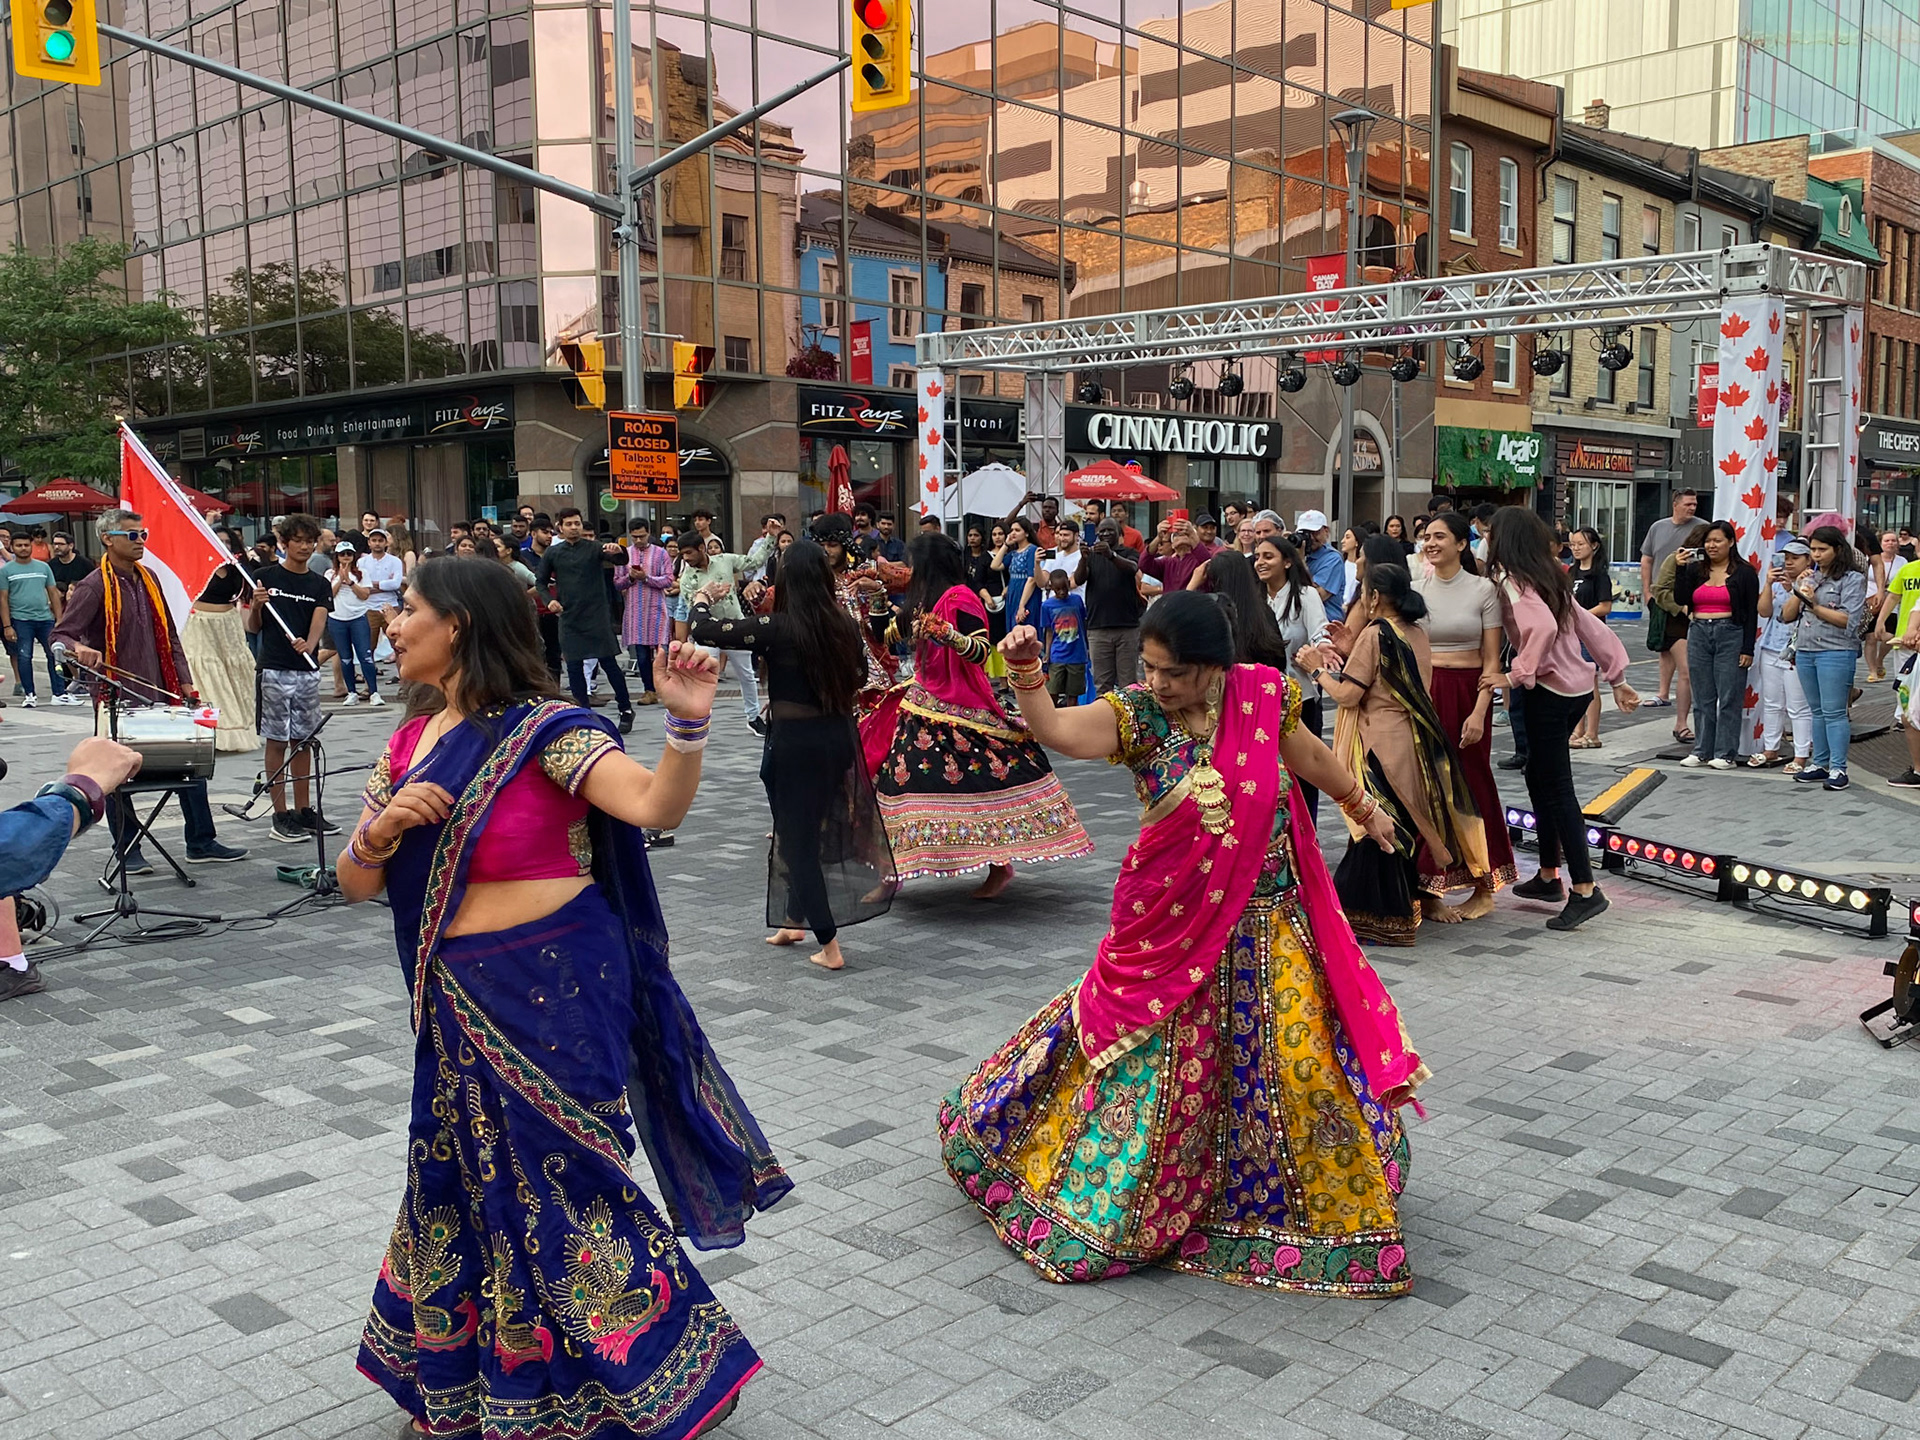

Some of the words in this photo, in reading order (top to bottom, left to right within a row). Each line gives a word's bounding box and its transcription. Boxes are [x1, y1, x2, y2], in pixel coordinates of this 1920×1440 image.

[1312, 273, 1339, 282] CANADA
[1316, 280, 1336, 290] DAY
[435, 408, 460, 422] FITZ
[462, 395, 505, 430] Rays
[811, 403, 845, 419] FITZ
[841, 393, 904, 433] Rays
[1701, 413, 1715, 422] LH
[277, 428, 298, 440] Food
[307, 424, 334, 437] Drinks
[343, 414, 411, 433] Entertainment
[624, 422, 662, 434] ROAD
[963, 415, 1003, 430] urant
[212, 435, 229, 446] FITZ
[1088, 413, 1269, 457] CINNAHOLIC
[1878, 431, 1894, 449] THE
[617, 436, 670, 450] CLOSED
[623, 453, 655, 463] Talbot
[656, 455, 666, 464] St
[1352, 455, 1377, 470] NDAS
[1604, 455, 1610, 469] &
[1611, 455, 1633, 471] GRILL
[648, 469, 667, 477] Carling
[554, 483, 573, 495] 110
[267, 587, 316, 603] Champion
